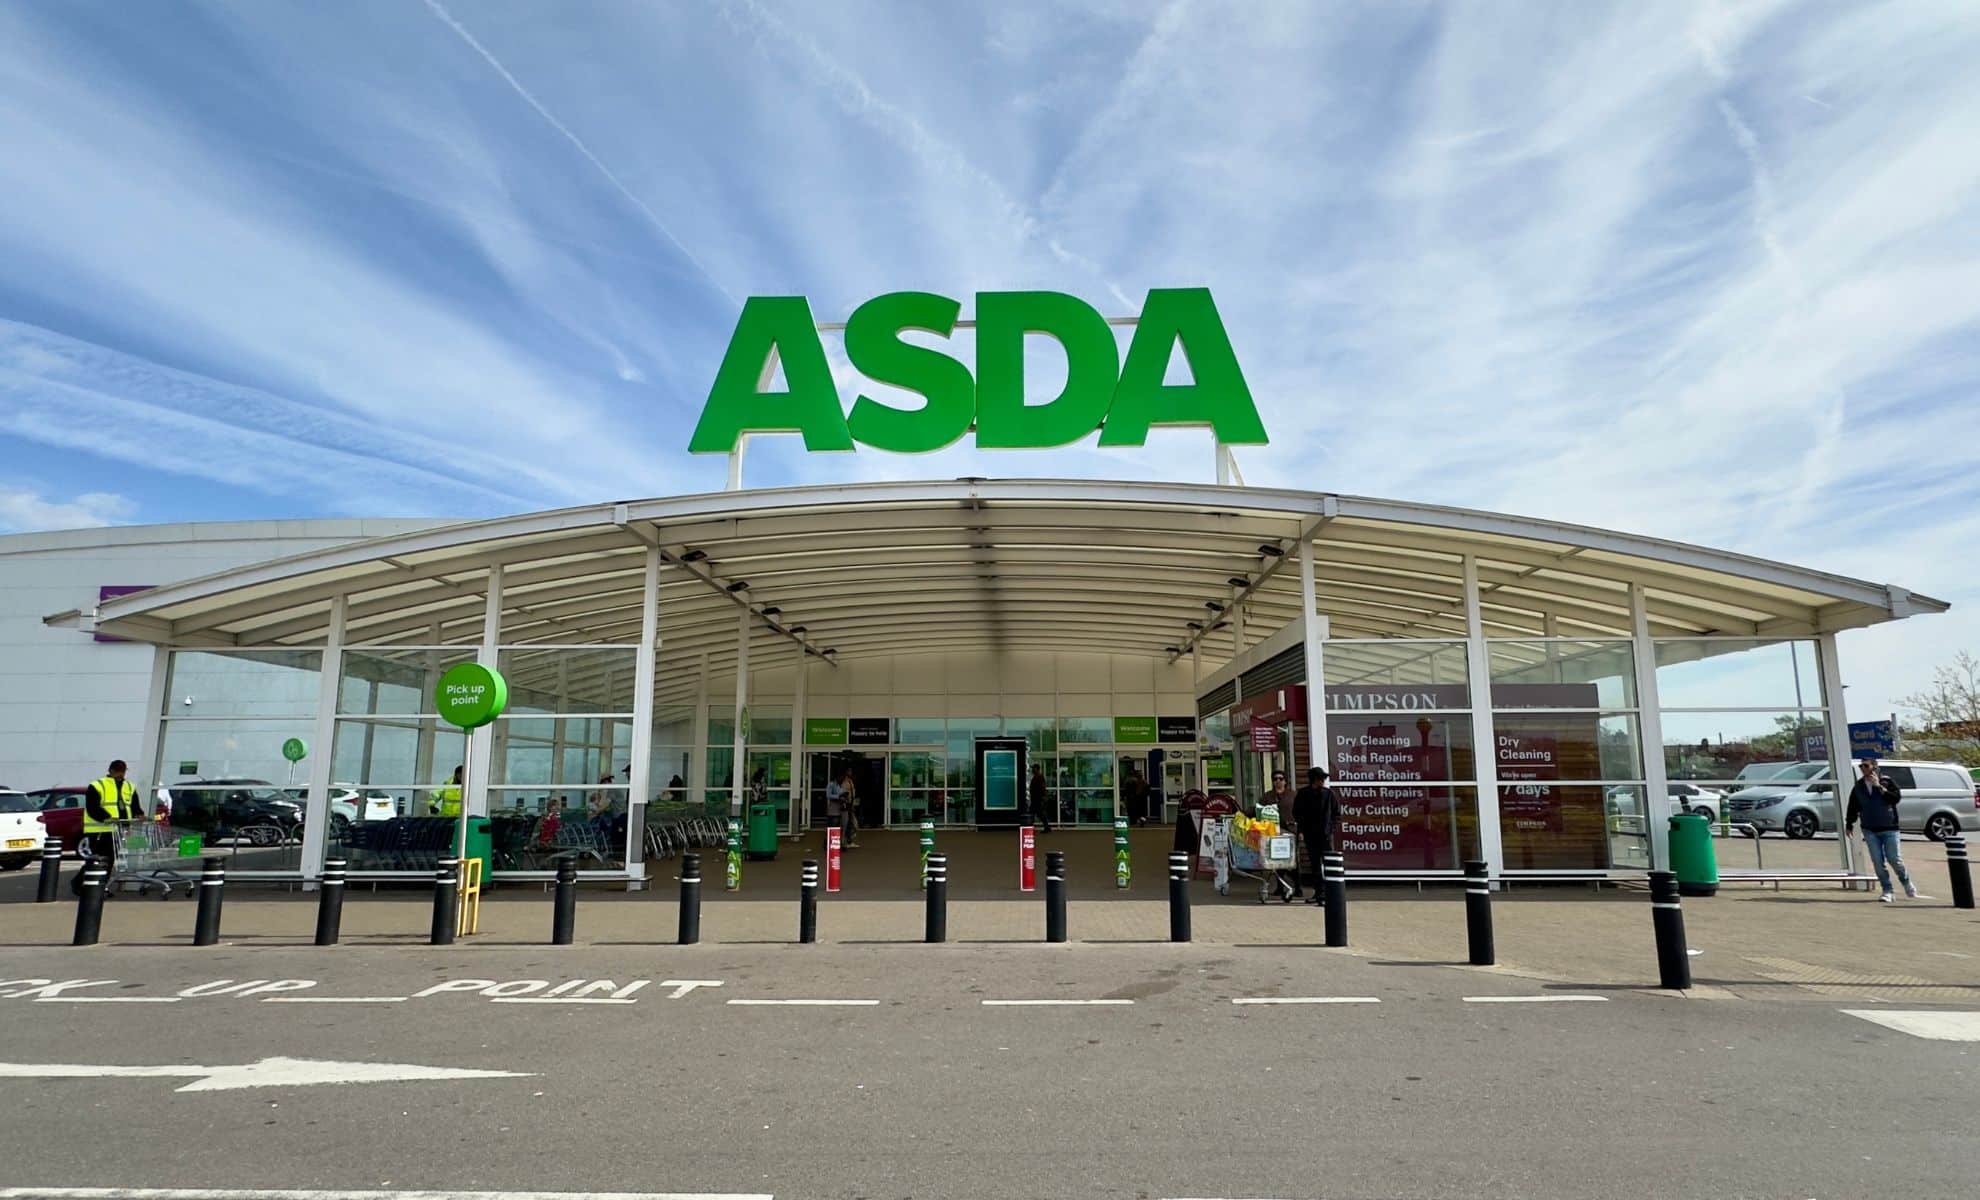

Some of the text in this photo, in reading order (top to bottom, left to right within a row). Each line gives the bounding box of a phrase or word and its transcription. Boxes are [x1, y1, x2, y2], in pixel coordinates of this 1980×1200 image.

[688, 287, 1269, 453] ASDA
[446, 684, 485, 695] Pick up
[451, 695, 479, 706] point
[1336, 735, 1411, 747] Dry Cleaning
[1499, 736, 1520, 749] Dry
[1337, 752, 1414, 765] Shoe Repairs
[1500, 749, 1552, 762] Cleaning
[1338, 770, 1422, 782] Phone Repairs
[1340, 787, 1424, 799] Watch Repairs
[1516, 785, 1550, 798] days
[1341, 805, 1409, 817] Key Cutting
[1341, 822, 1400, 835] Engraving
[1342, 840, 1393, 850] Photo ID
[177, 979, 317, 998] UP
[411, 979, 725, 999] POINT
